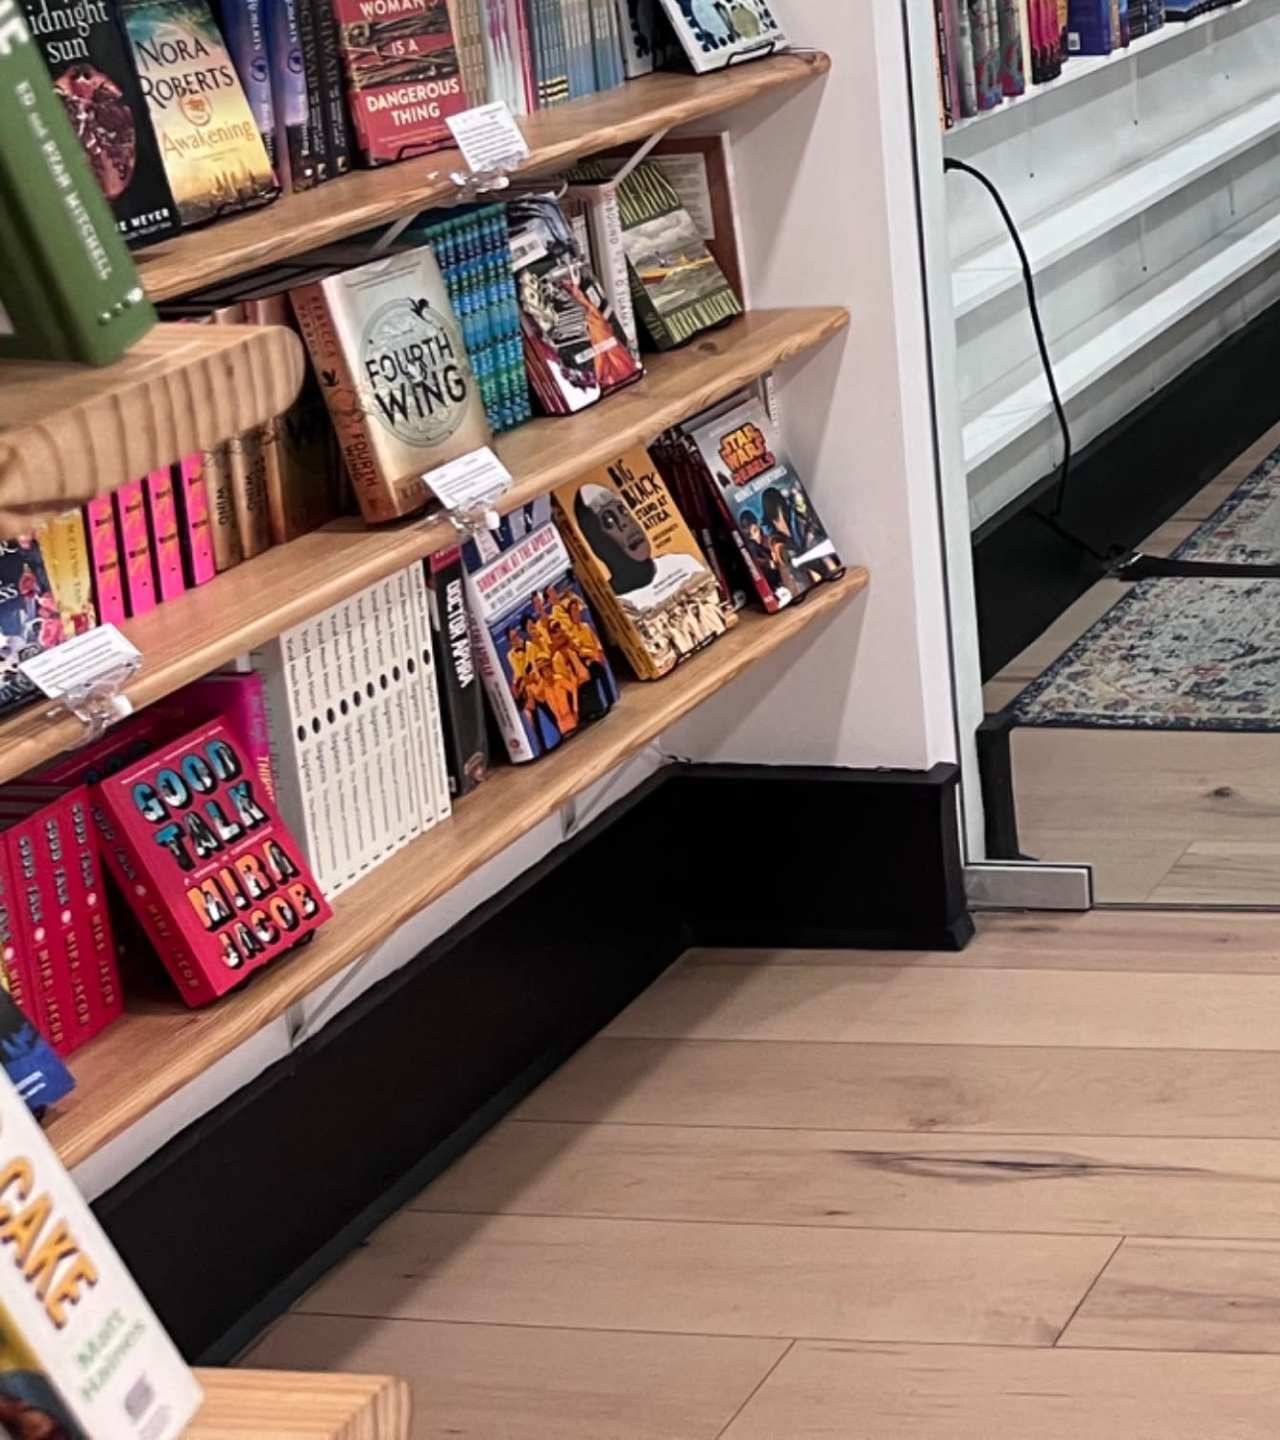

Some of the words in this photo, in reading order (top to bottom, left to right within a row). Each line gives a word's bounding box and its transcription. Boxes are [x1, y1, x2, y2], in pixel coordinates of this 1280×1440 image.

[46, 36, 91, 63] sun
[135, 35, 210, 71] NORA
[392, 39, 408, 55] IS
[409, 39, 419, 53] A
[138, 64, 235, 110] ROBERTS
[365, 77, 461, 112] DANGEROUS
[391, 102, 441, 127] THING
[162, 120, 255, 158] Awakening
[42, 139, 73, 189] RYAN
[63, 190, 113, 280] MITCHELL
[131, 207, 170, 228] MEYER
[365, 332, 454, 389] FOURTH
[375, 365, 468, 427] WING
[345, 445, 362, 481] WING
[353, 432, 379, 488] FOURTH
[607, 458, 634, 488] BIG
[214, 487, 230, 525] WING
[620, 471, 663, 509] BLACK
[643, 511, 671, 531] ATTICA
[446, 579, 471, 644] DOCTOR
[452, 643, 475, 689] APHRA
[132, 739, 242, 823] GOOD
[45, 819, 63, 862] GOOD
[72, 803, 88, 846] GOOD
[155, 781, 270, 871] TALK
[19, 834, 35, 879] GOOD
[79, 849, 95, 889] TALK
[26, 884, 43, 924] TALK
[53, 866, 70, 906] TALK
[186, 840, 300, 933] MIRA
[219, 884, 320, 970] JACOB
[37, 948, 54, 990] MIRA
[65, 931, 80, 976] MIRA
